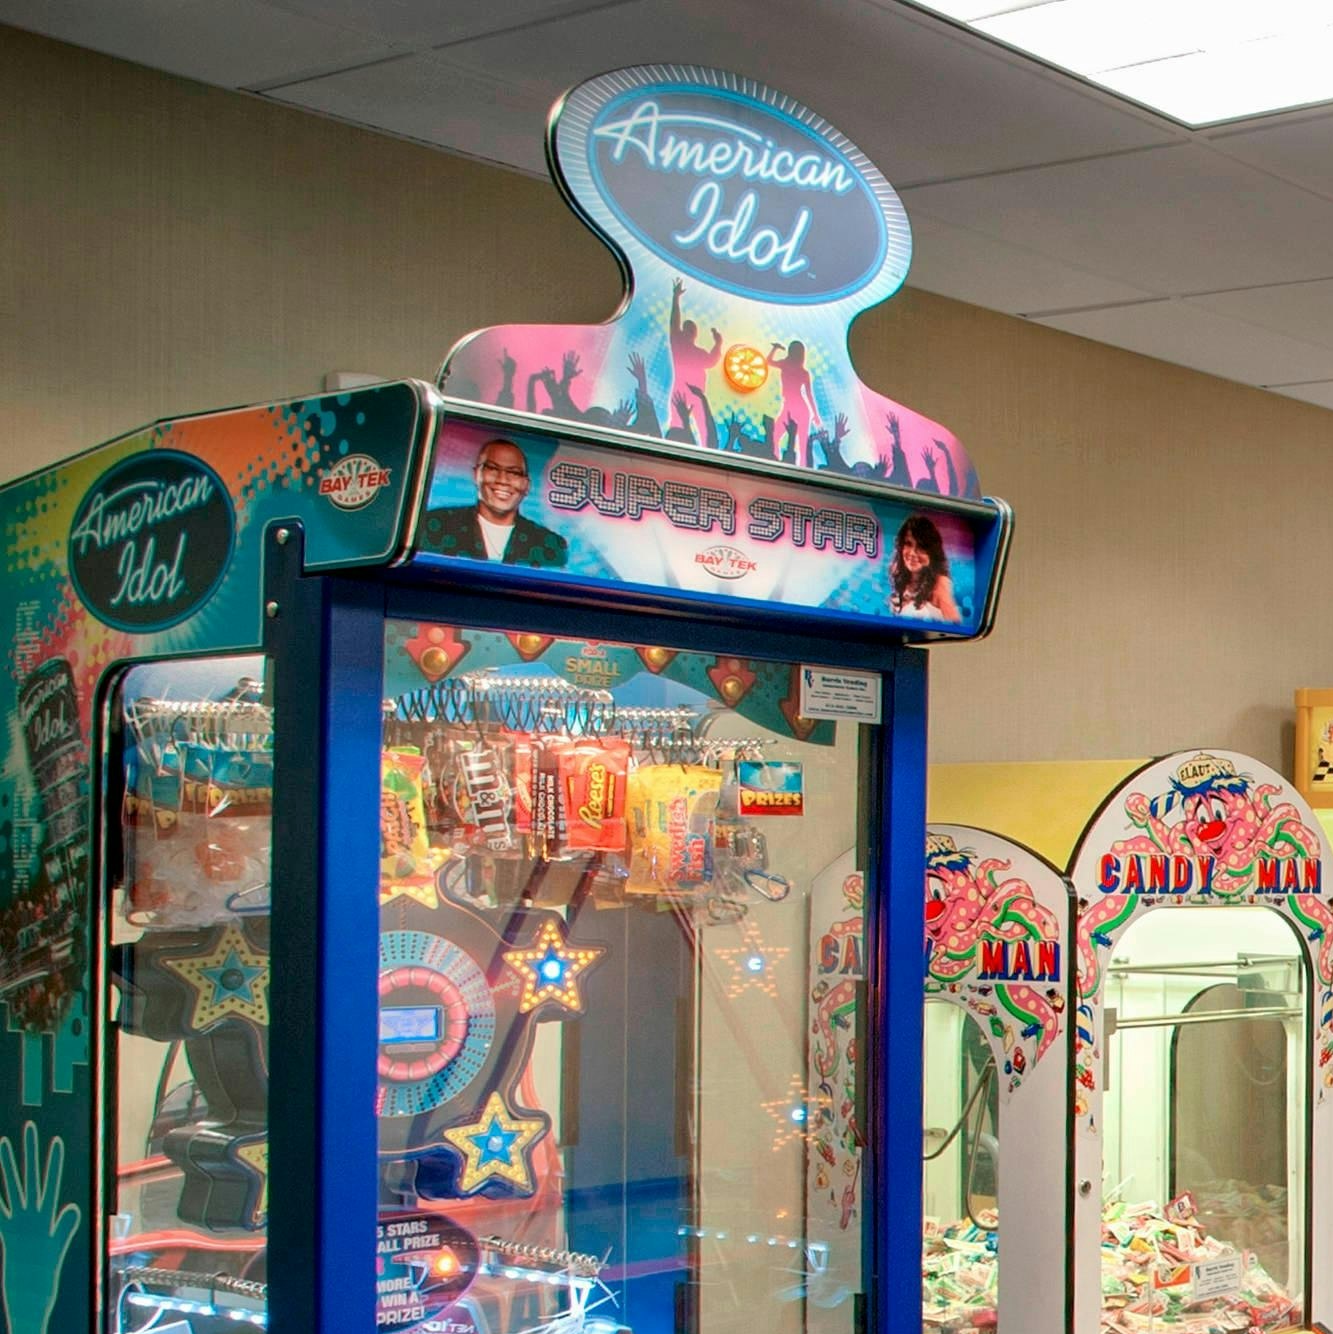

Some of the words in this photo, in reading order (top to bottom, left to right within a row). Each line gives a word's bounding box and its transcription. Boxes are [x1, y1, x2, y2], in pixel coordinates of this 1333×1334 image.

[593, 101, 853, 192] American
[674, 183, 811, 274] Idol
[320, 476, 352, 493] BAY
[357, 468, 390, 486] TEK
[72, 473, 213, 553] American
[548, 461, 736, 537] SUPER
[747, 496, 880, 559] STAR
[111, 534, 186, 606] Idol
[694, 554, 724, 565] BAY
[729, 559, 757, 571] TEK
[566, 656, 621, 676] SMALL
[579, 763, 605, 829] Reese's
[741, 791, 802, 807] PRIZES
[1098, 853, 1217, 895] CANDY
[1255, 857, 1322, 894] MAN
[978, 939, 1060, 982] MAN
[377, 1240, 401, 1253] ALL
[403, 1234, 440, 1250] PRIZE
[387, 1221, 428, 1237] STARS
[376, 1277, 411, 1292] MORE
[381, 1293, 408, 1308] WIN
[408, 1293, 419, 1304] A
